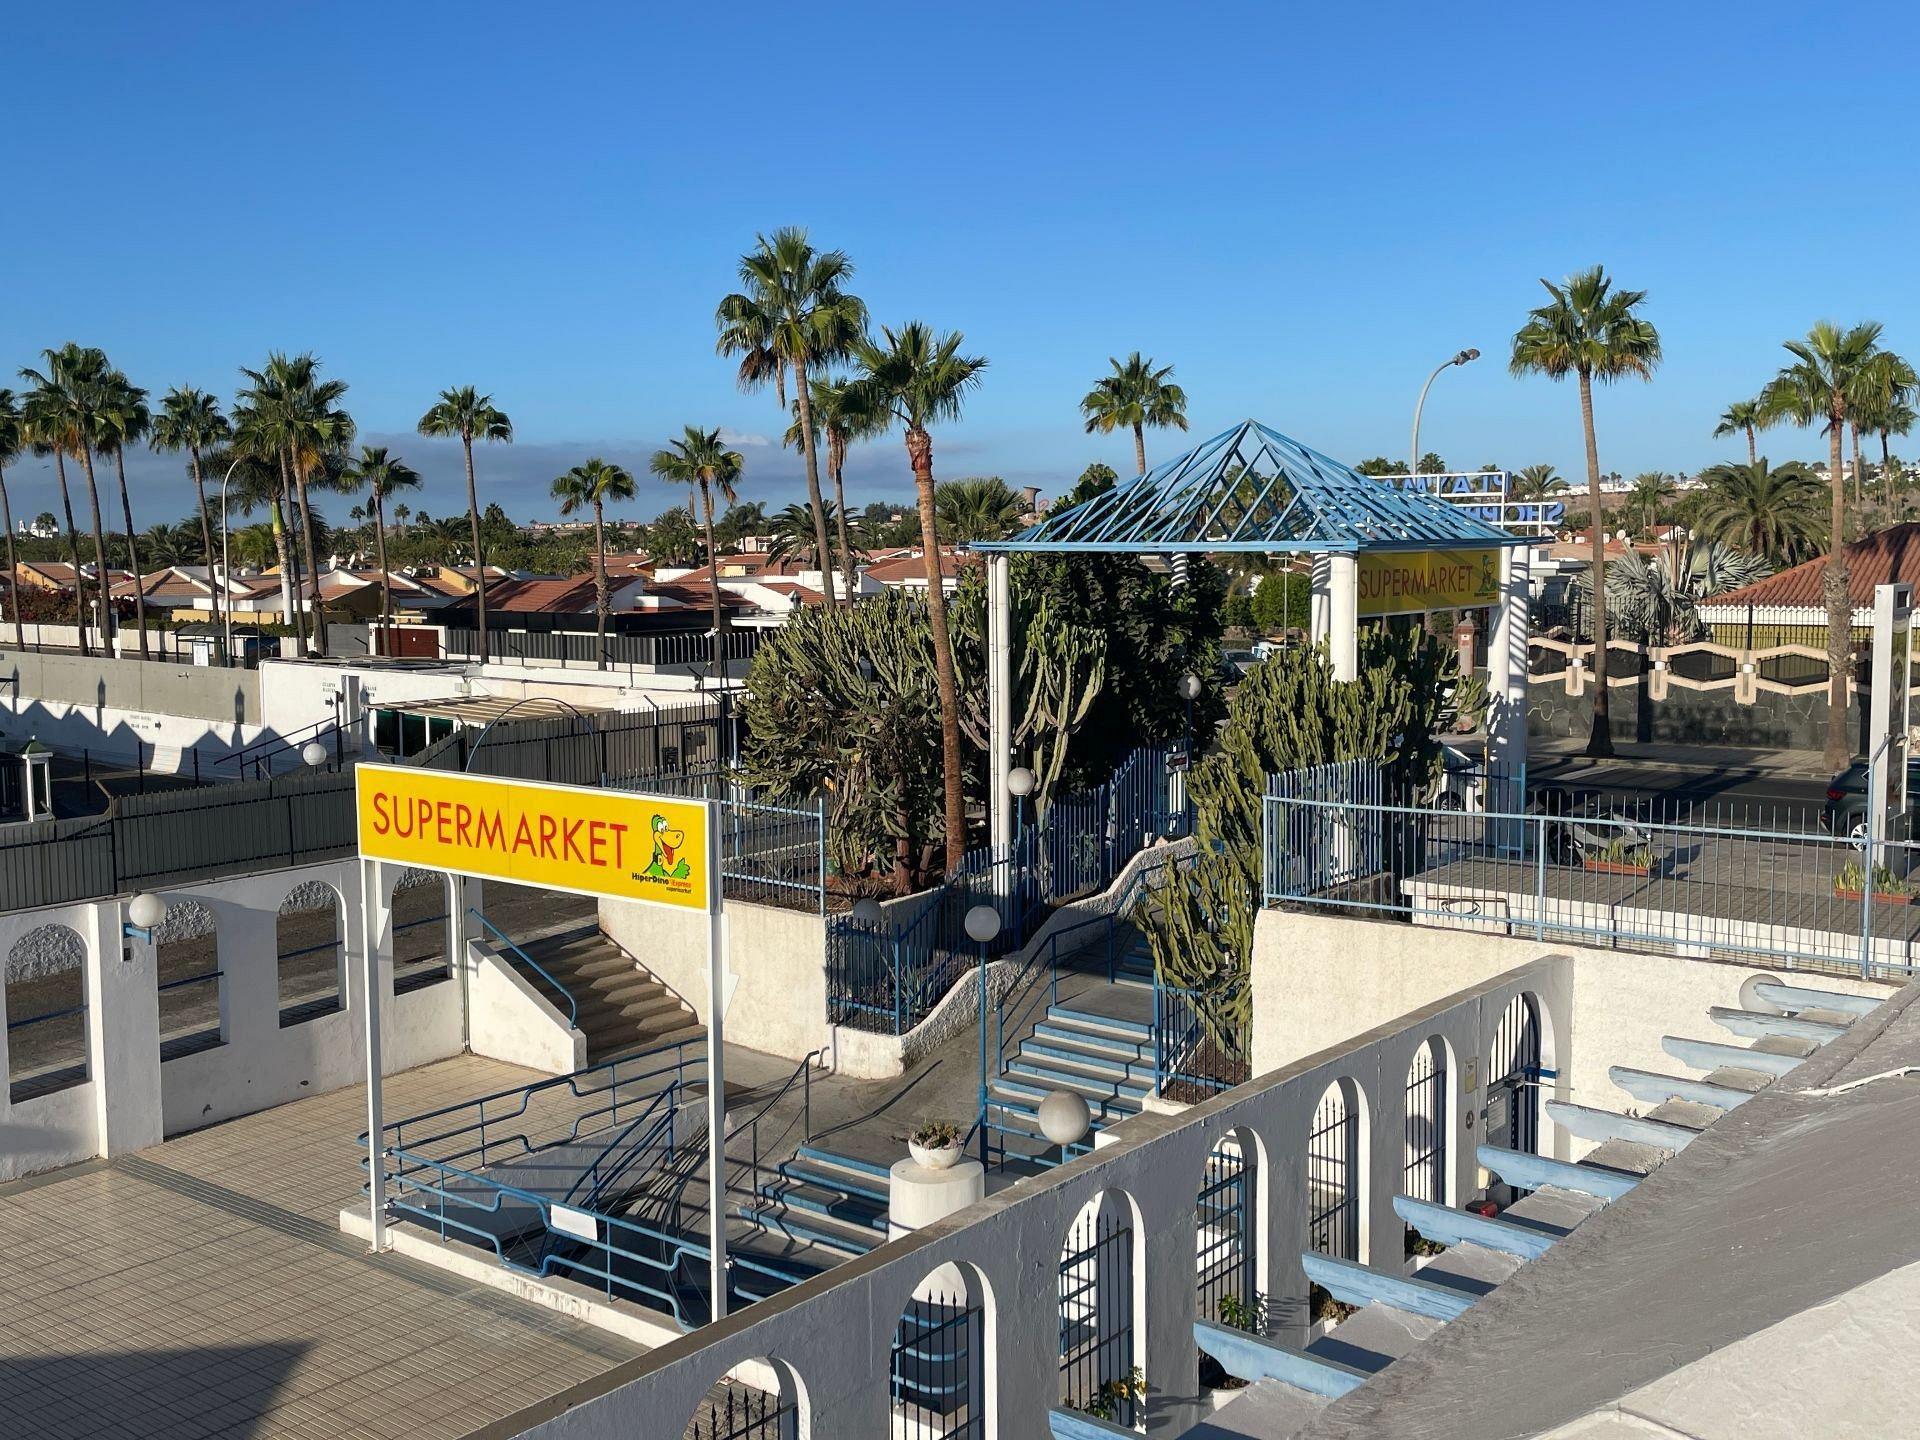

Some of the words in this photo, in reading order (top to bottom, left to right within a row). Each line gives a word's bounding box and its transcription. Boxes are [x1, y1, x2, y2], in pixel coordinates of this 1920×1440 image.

[1360, 565, 1473, 599] SUPERMARKET
[373, 792, 628, 869] SUPERMARKET
[632, 872, 669, 885] HiperDino
